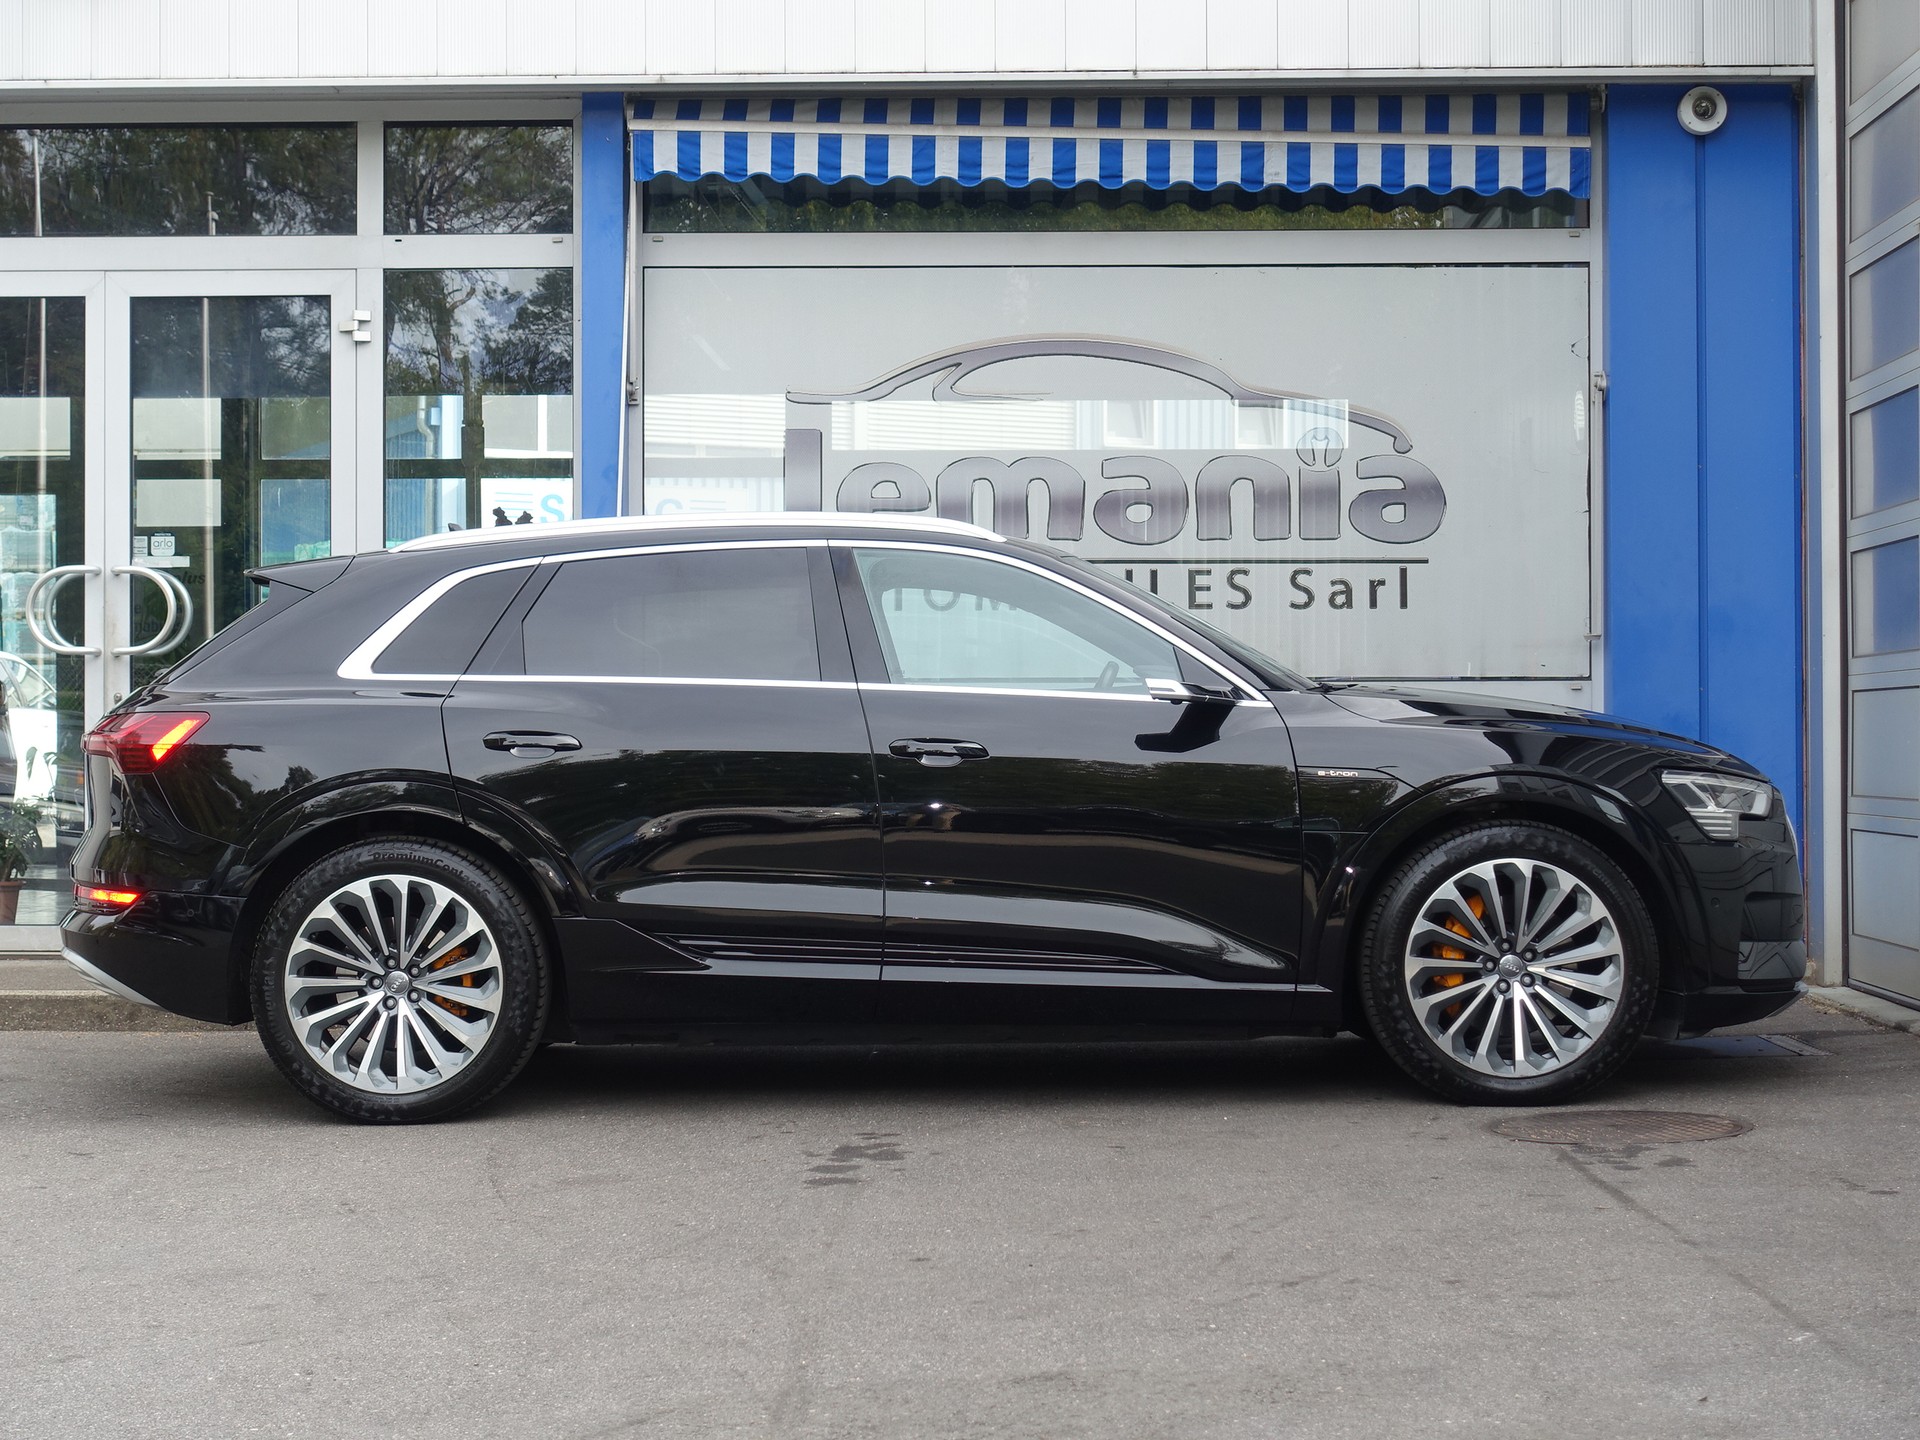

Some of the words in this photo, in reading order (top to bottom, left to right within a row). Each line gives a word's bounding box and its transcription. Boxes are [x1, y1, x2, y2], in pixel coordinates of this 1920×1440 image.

[783, 427, 1447, 545] lemania
[152, 537, 173, 547] arlo
[177, 570, 206, 585] lus
[1288, 566, 1408, 610] Sarl
[1317, 769, 1359, 777] e-tron
